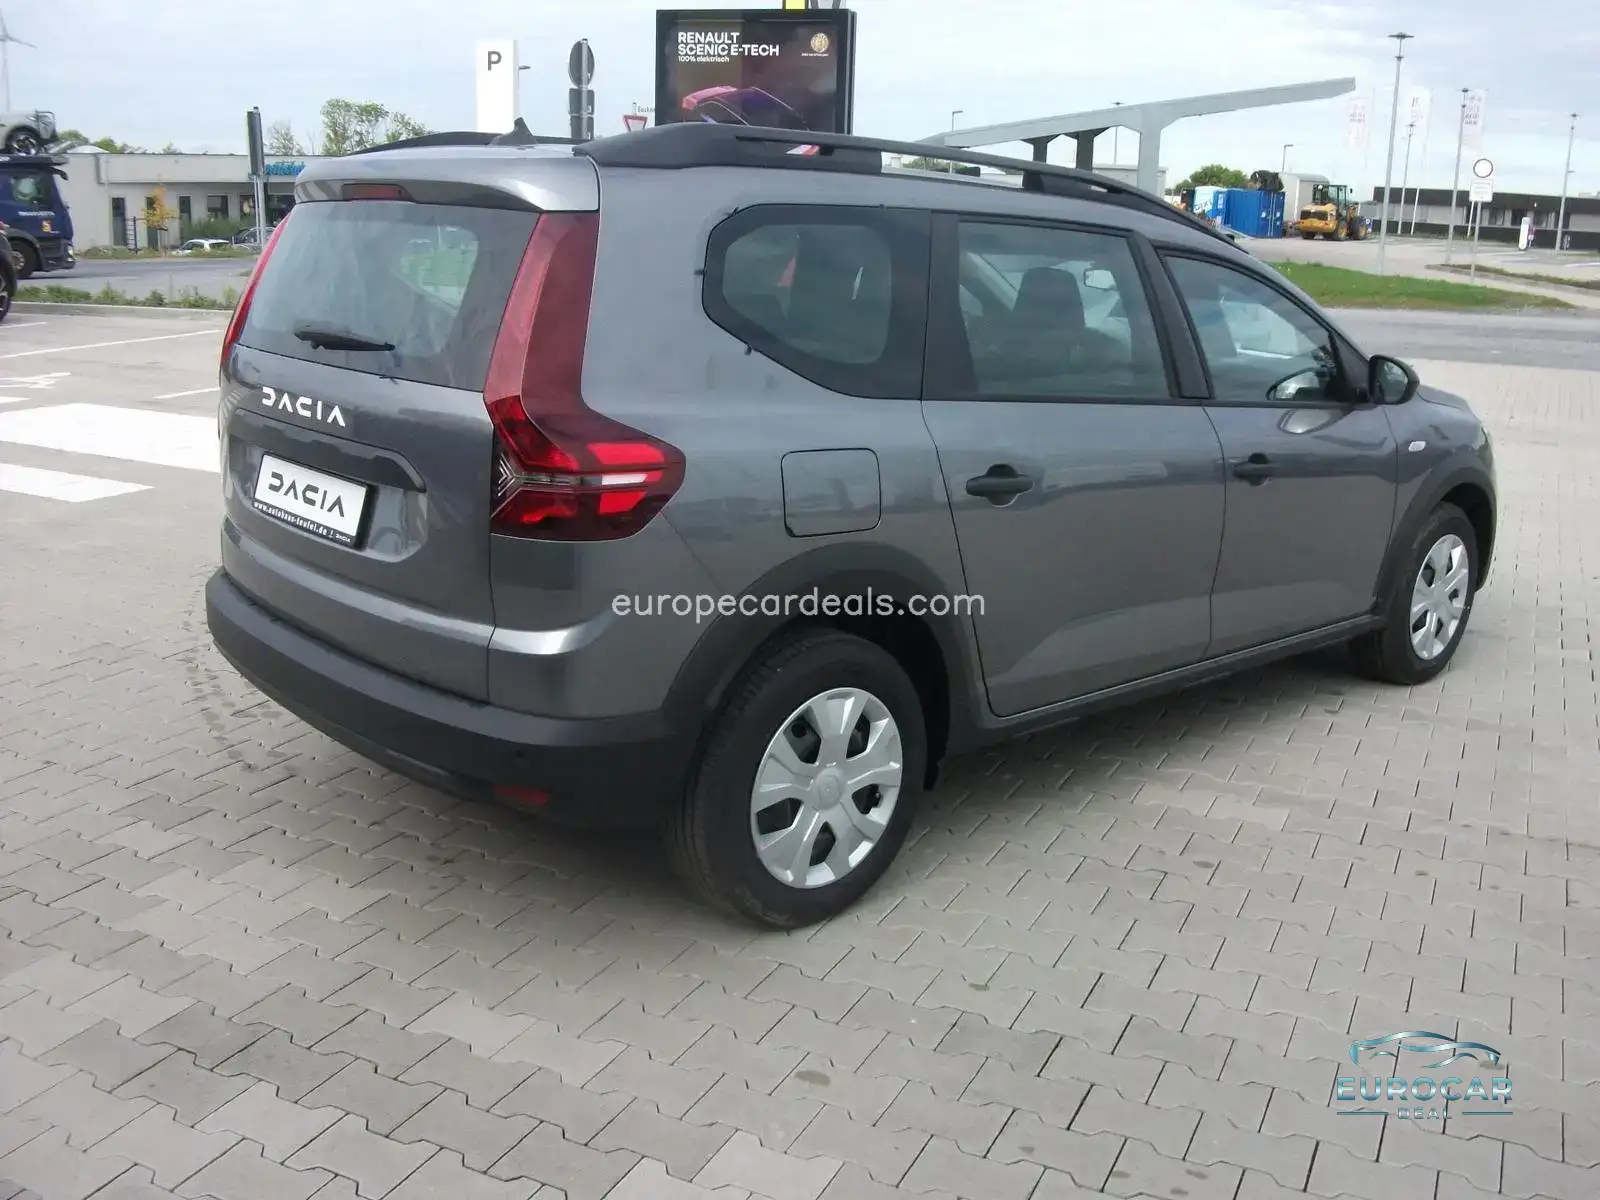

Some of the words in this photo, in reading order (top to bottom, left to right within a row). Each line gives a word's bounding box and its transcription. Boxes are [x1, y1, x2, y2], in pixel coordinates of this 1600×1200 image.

[677, 31, 740, 44] RENAULT
[677, 43, 729, 56] SCENIC
[730, 45, 780, 57] E-TECH
[487, 51, 502, 71] P
[678, 55, 696, 63] 100%
[696, 55, 730, 63] elektrisch
[262, 386, 346, 427] DACIA
[268, 471, 345, 518] DACIA
